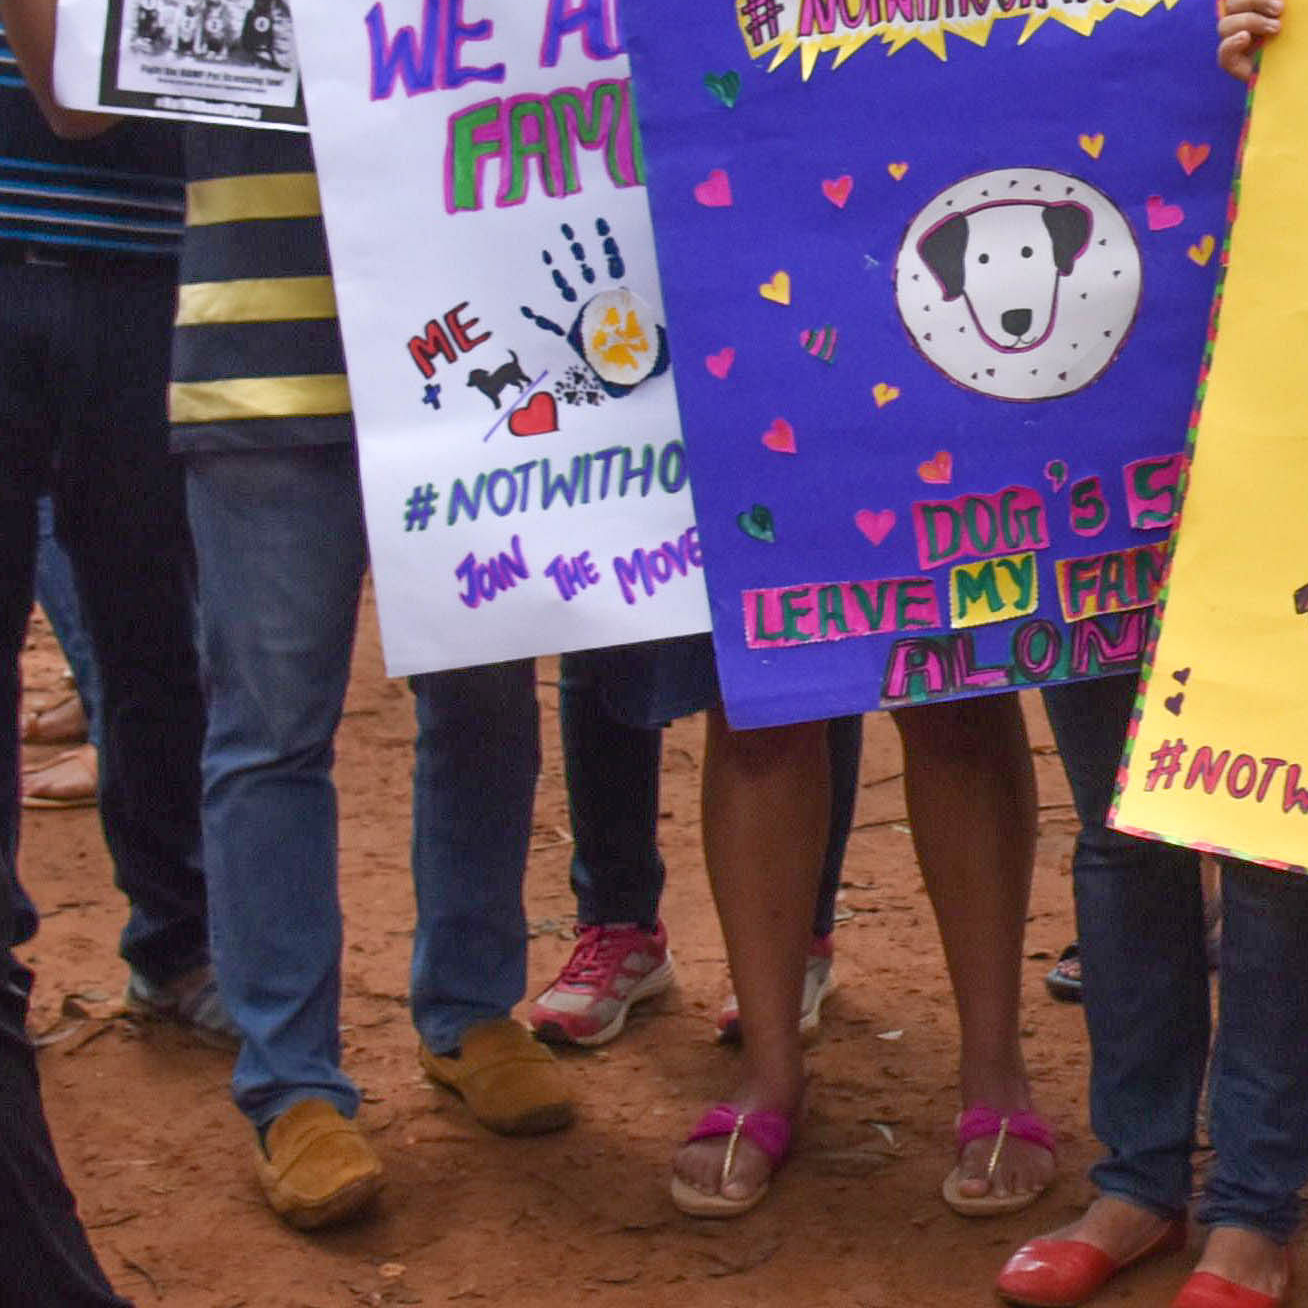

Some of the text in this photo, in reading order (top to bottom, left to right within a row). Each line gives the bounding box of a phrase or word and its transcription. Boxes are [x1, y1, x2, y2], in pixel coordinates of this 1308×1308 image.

[408, 301, 493, 380] ME
[454, 534, 530, 610] JOIN
[544, 550, 600, 602] THE
[754, 578, 938, 643] LEAVE
[954, 553, 1034, 620] MY
